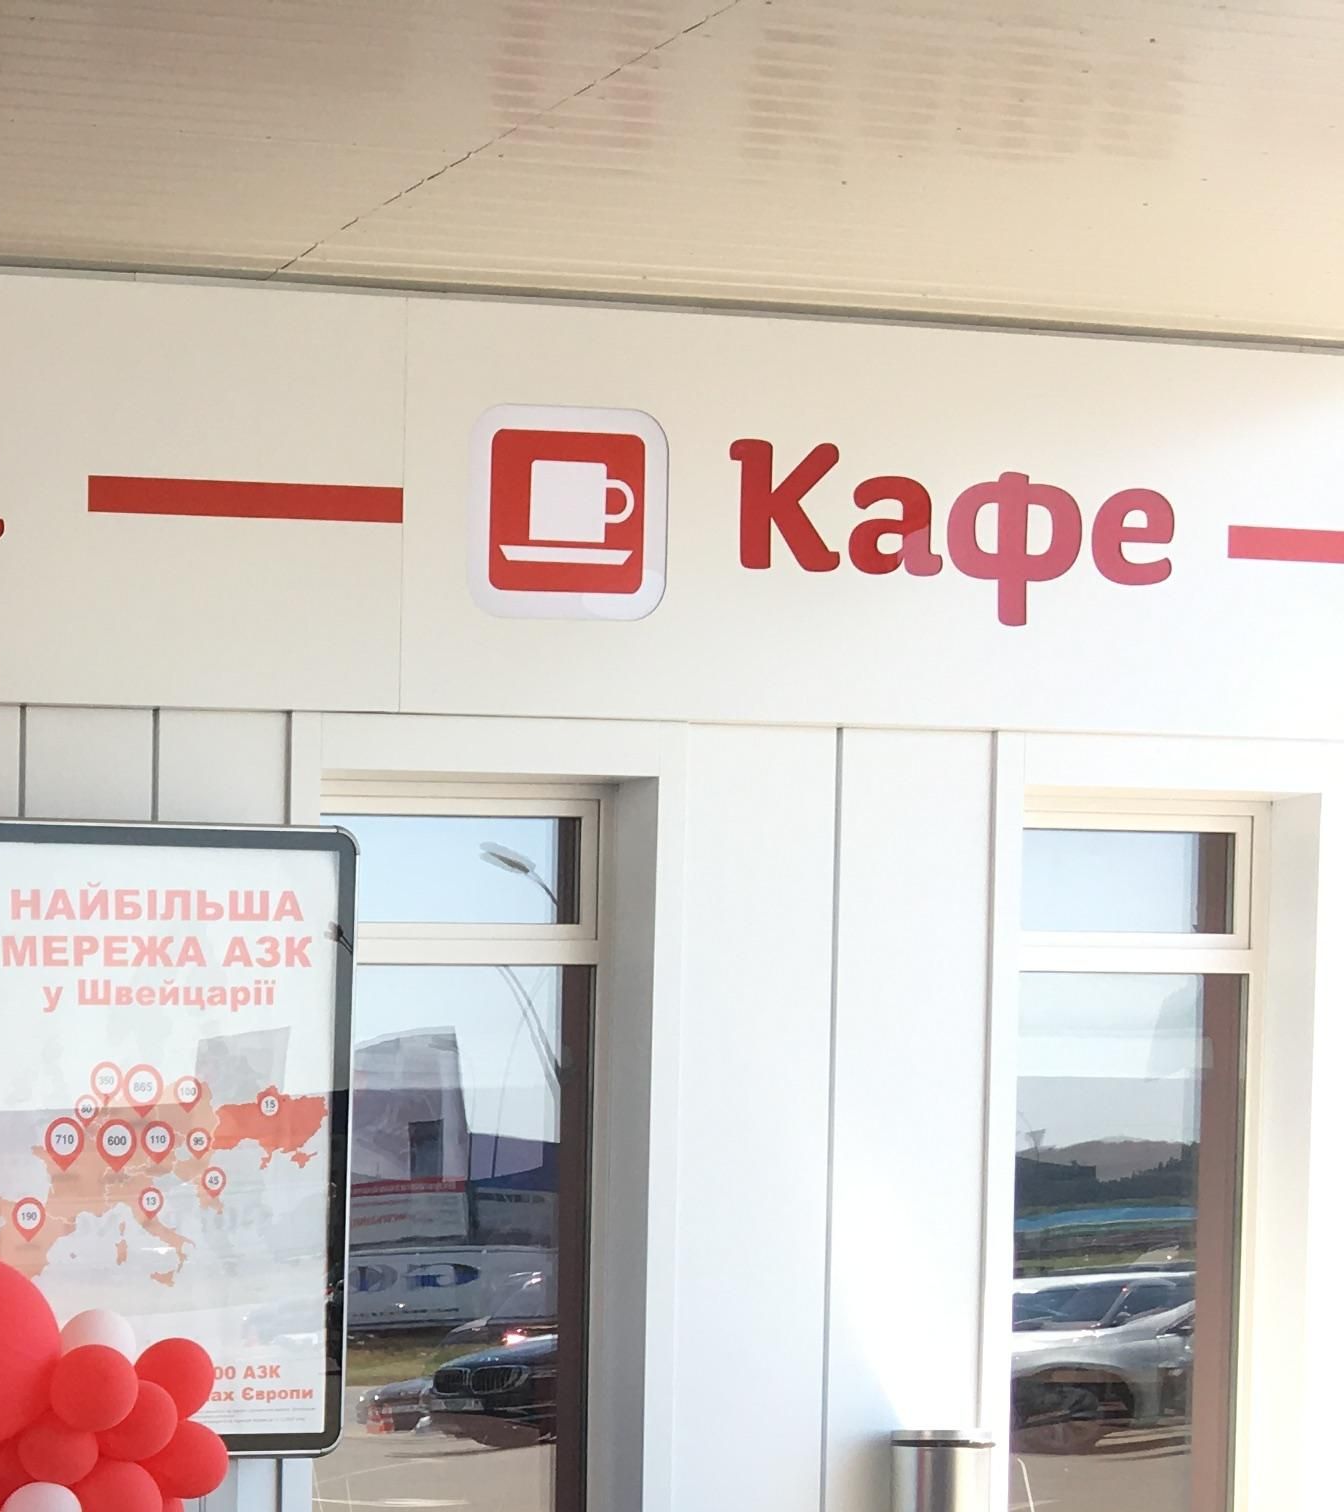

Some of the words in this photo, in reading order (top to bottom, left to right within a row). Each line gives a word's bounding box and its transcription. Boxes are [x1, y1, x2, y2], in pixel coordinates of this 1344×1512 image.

[729, 438, 1176, 627] Кафе
[10, 881, 305, 923] НАЙБІЛЬША
[0, 935, 207, 968] МЕРЕЖА
[221, 935, 313, 968] АЗК
[42, 986, 63, 1013] у
[77, 979, 277, 1012] Швейцарії
[263, 1099, 274, 1109] 15
[55, 1134, 74, 1145] 710
[107, 1135, 127, 1146] 600
[150, 1134, 166, 1145] 110
[208, 1175, 219, 1186] 45
[145, 1196, 156, 1206] 13
[21, 1211, 37, 1222] 190
[243, 1365, 281, 1379] АЗК
[241, 1387, 314, 1403] Європи
